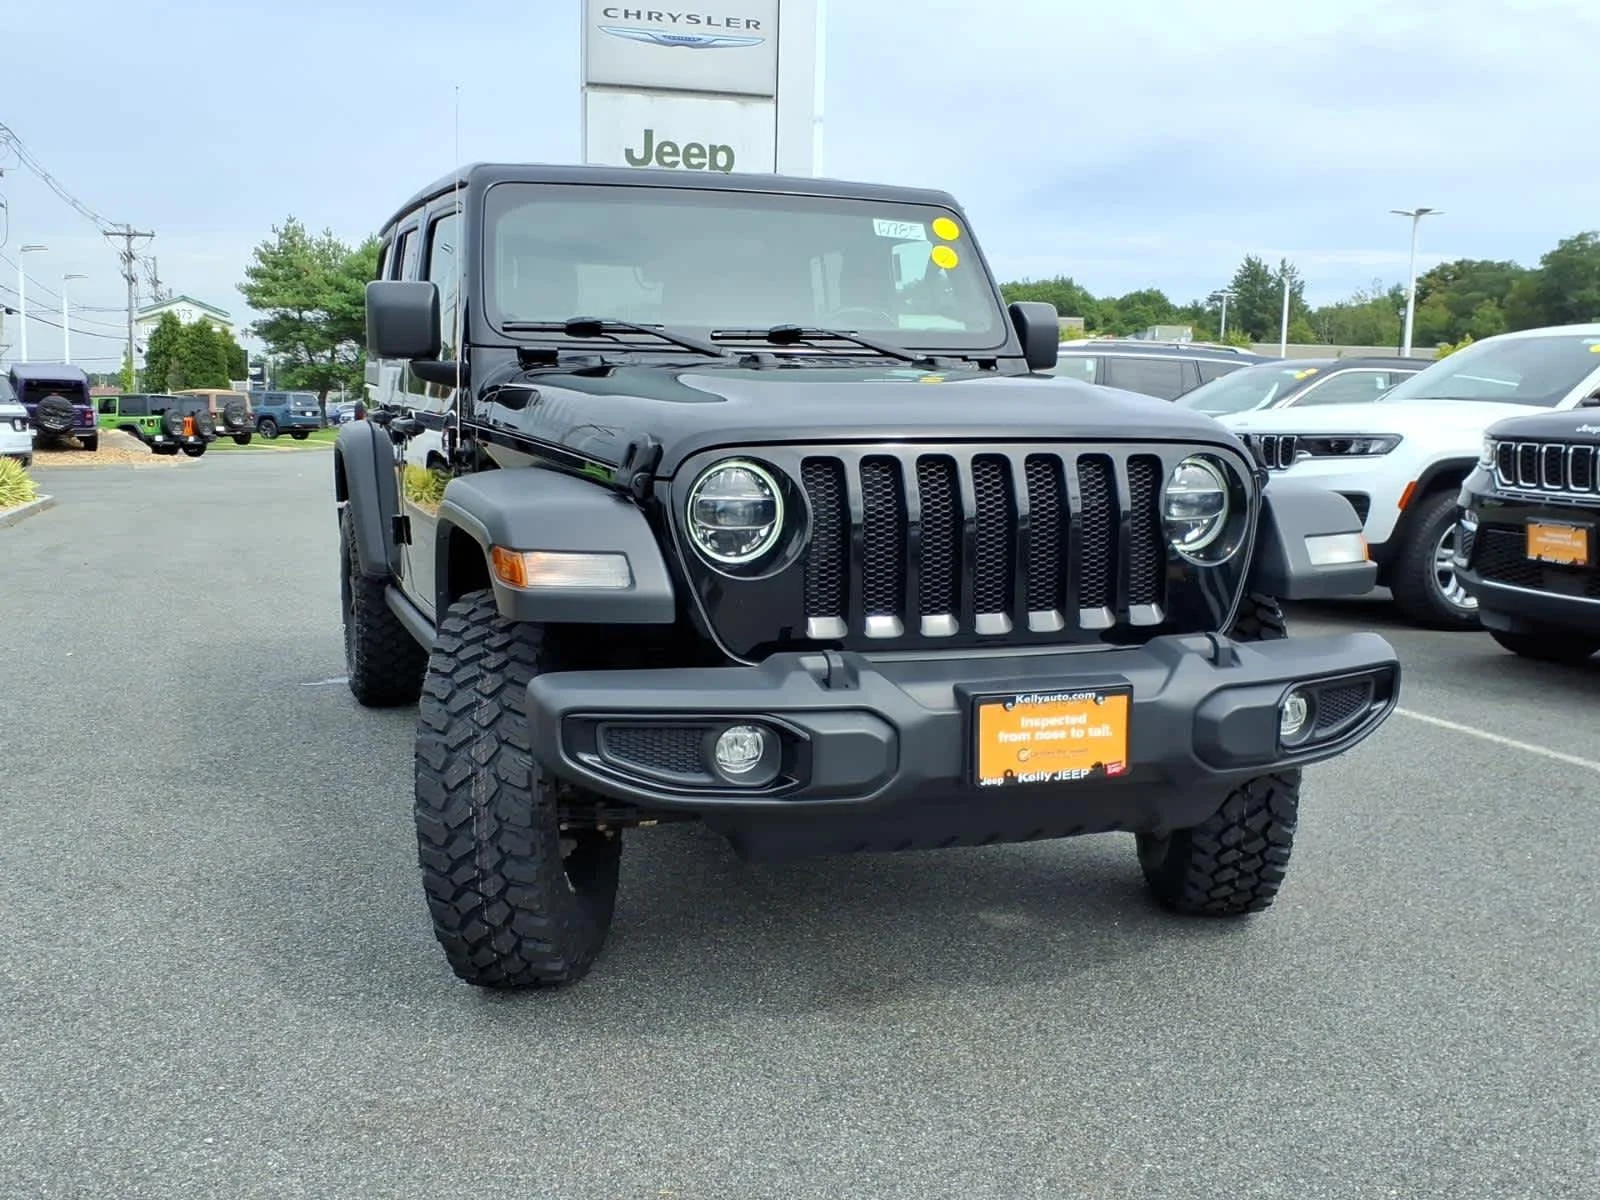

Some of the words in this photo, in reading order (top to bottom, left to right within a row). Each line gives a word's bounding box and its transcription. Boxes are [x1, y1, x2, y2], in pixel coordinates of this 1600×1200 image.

[603, 7, 761, 30] CHRYSLER
[624, 128, 735, 172] Jeep
[1016, 692, 1096, 704] Kellyauto.com
[1021, 713, 1087, 729] Inspected
[998, 731, 1031, 743] from
[1070, 726, 1085, 738] to
[1018, 770, 1053, 784] Kelly
[1054, 768, 1089, 781] JEEP
